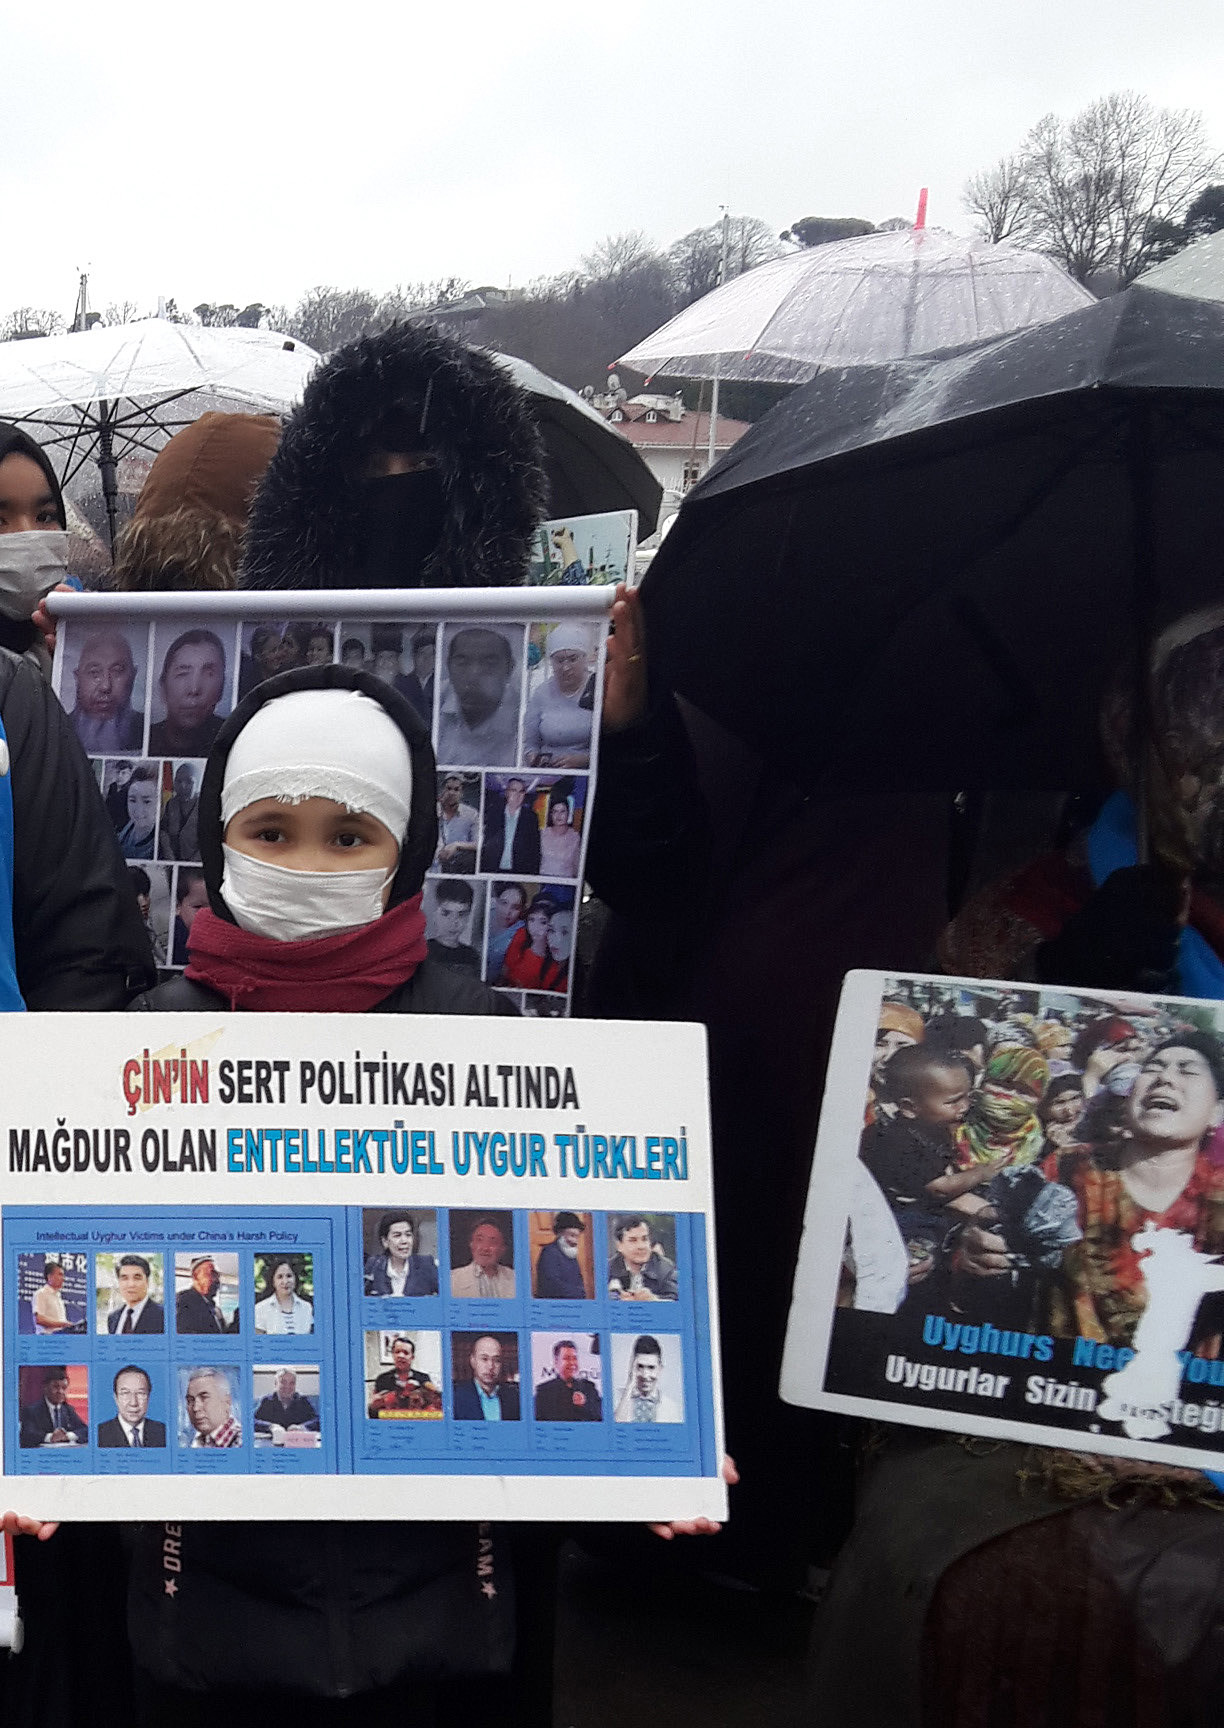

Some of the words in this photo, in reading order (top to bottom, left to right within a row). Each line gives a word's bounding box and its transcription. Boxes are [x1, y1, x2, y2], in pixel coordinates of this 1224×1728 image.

[219, 1060, 290, 1104] SERT
[301, 1051, 455, 1107] POLİTİKASI
[464, 1065, 579, 1110] ALTINDA
[9, 1118, 132, 1173] MAĞDUR
[141, 1128, 216, 1173] OLAN
[228, 1120, 444, 1176] ENTELLEKTÜEL
[453, 1132, 546, 1178] UYGUR
[555, 1126, 688, 1180] TÜRKLERİ
[36, 1230, 89, 1242] Intellectual
[91, 1230, 127, 1244] Uyghur
[130, 1230, 164, 1242] Victims
[167, 1230, 195, 1242] under
[198, 1230, 234, 1242] China's
[237, 1230, 266, 1242] Harsh
[269, 1230, 298, 1243] Policy
[923, 1314, 1054, 1362] Uyghurs
[884, 1354, 1011, 1399] Uygurlar
[1025, 1376, 1097, 1413] Sizin
